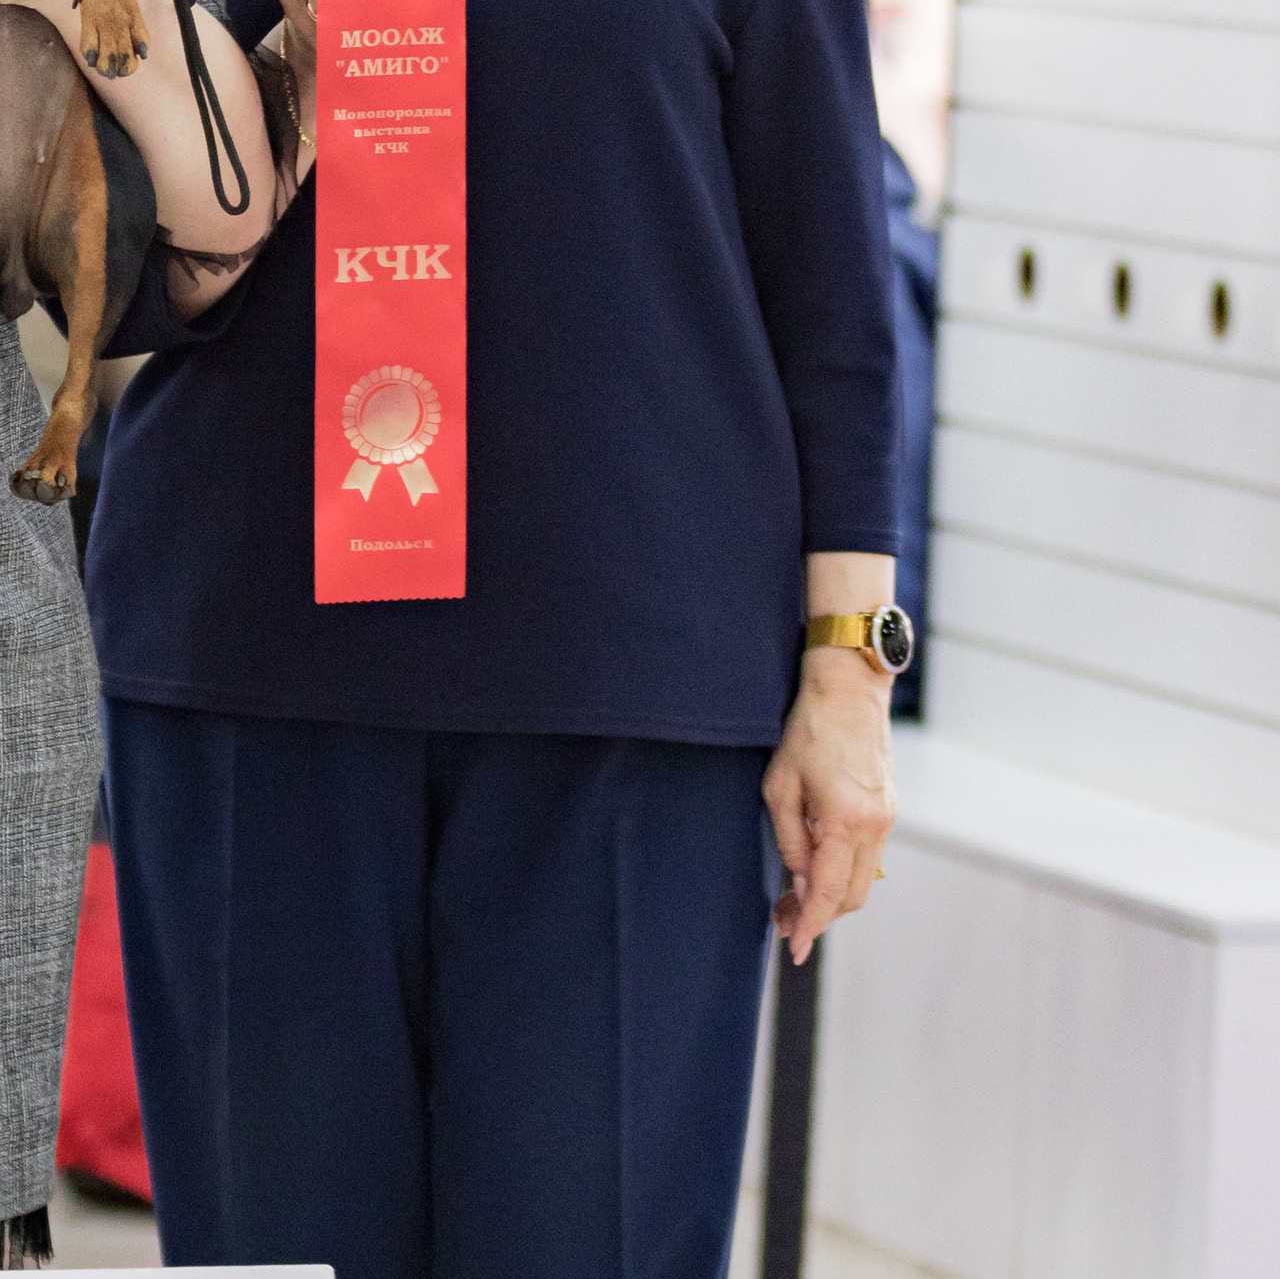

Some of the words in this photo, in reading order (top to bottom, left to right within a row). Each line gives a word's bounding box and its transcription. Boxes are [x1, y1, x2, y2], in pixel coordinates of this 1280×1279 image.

[340, 27, 445, 48] МООЛЖ
[336, 56, 449, 78] "АМИГО"
[333, 107, 452, 121] Монопородная
[354, 125, 430, 138] выставка
[374, 142, 409, 154] КЧК
[334, 244, 452, 283] КЧК
[349, 538, 434, 552] Подольск
